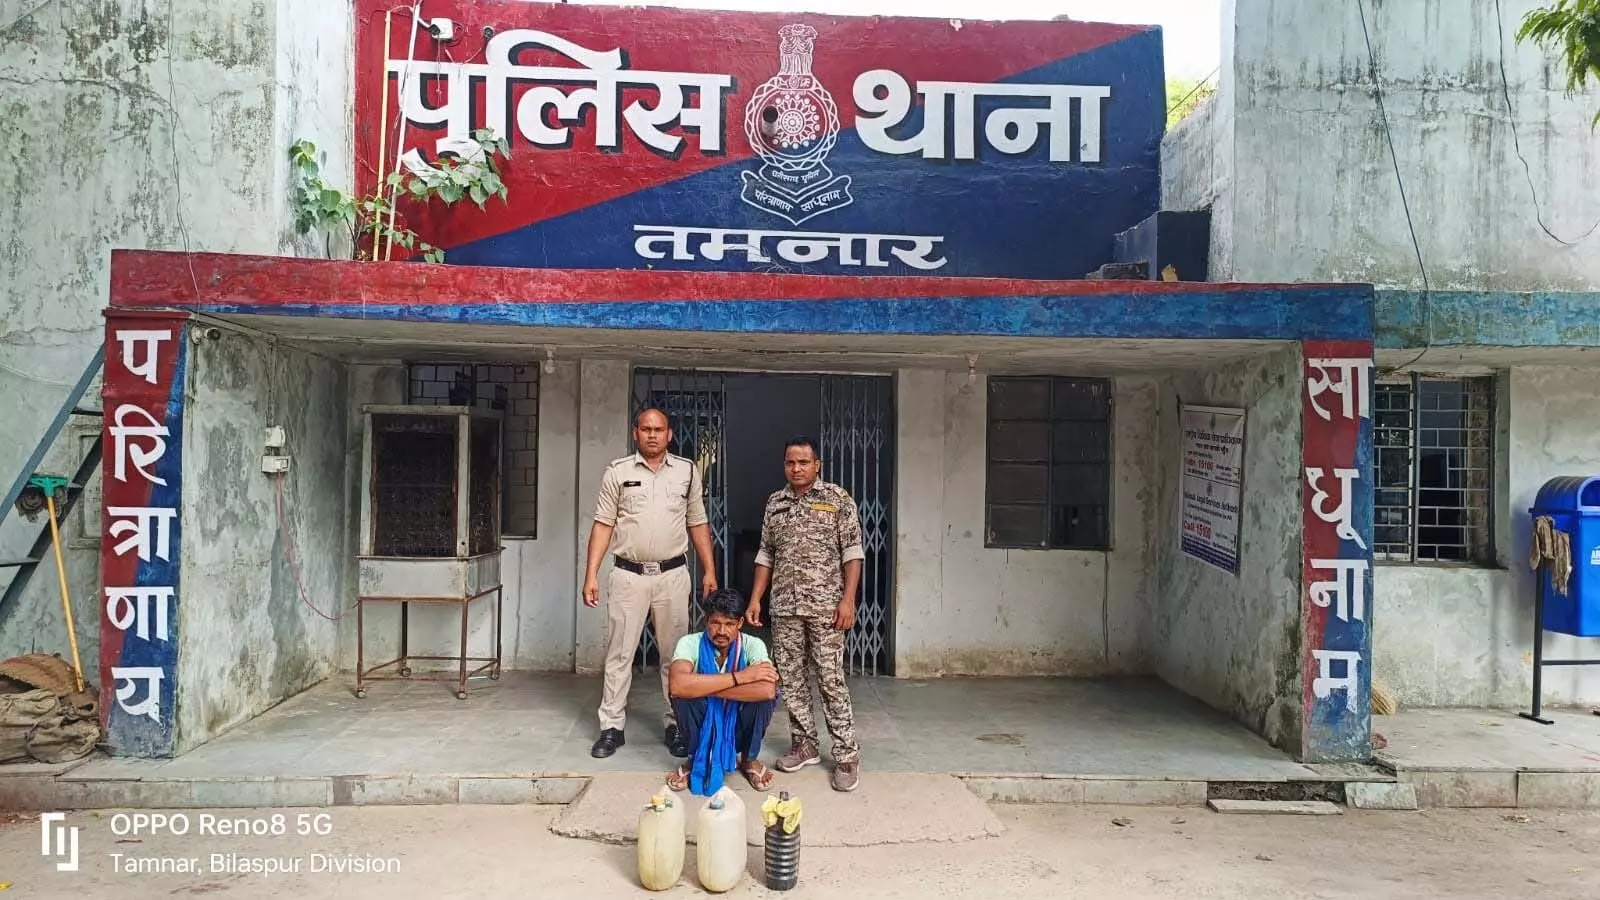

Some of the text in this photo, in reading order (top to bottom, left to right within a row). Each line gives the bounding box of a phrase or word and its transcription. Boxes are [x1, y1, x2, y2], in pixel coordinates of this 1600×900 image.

[388, 29, 1111, 185] पुलिस थाना
[754, 188, 794, 212] परित्राणाय
[633, 225, 948, 269] तमनार
